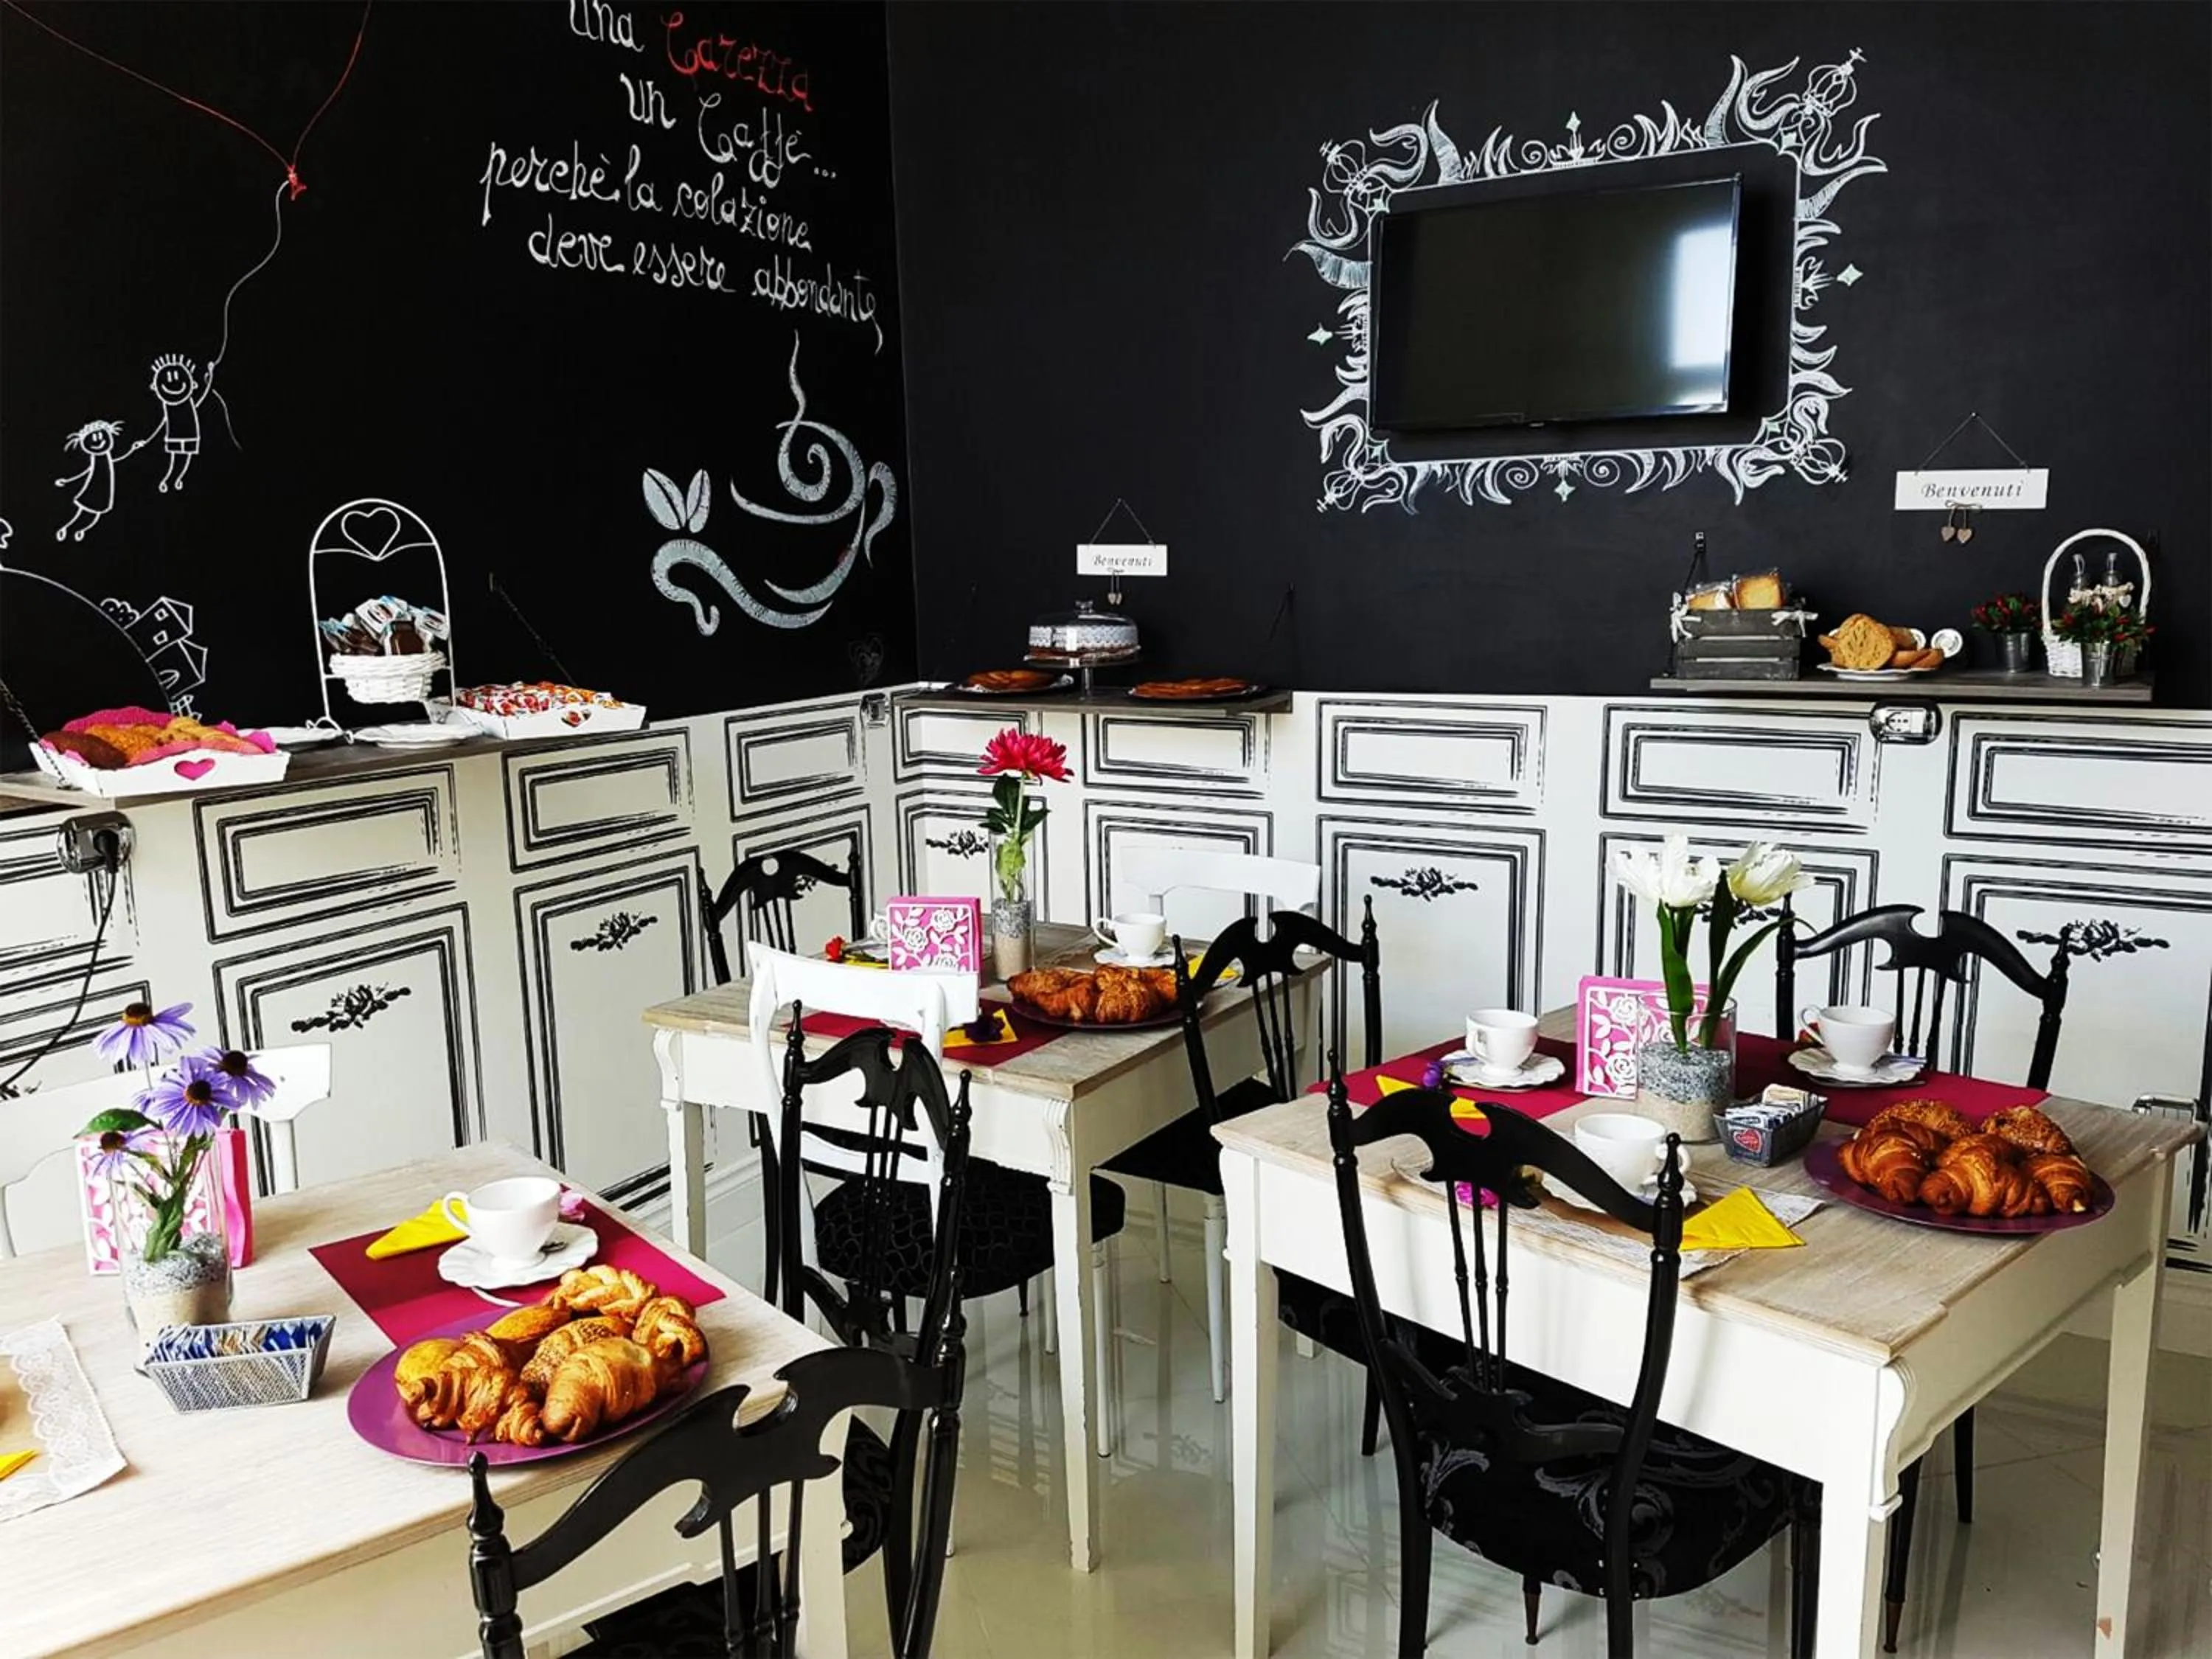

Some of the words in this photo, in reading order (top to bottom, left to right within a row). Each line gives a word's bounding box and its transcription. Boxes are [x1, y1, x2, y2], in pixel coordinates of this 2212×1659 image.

[479, 139, 621, 227] perchè
[625, 144, 663, 212] la
[672, 171, 813, 254] colazione
[528, 212, 625, 273] deve
[632, 242, 737, 293] essere
[1920, 480, 2025, 499] Benvenuti
[1093, 554, 1152, 568] Benvenuti
